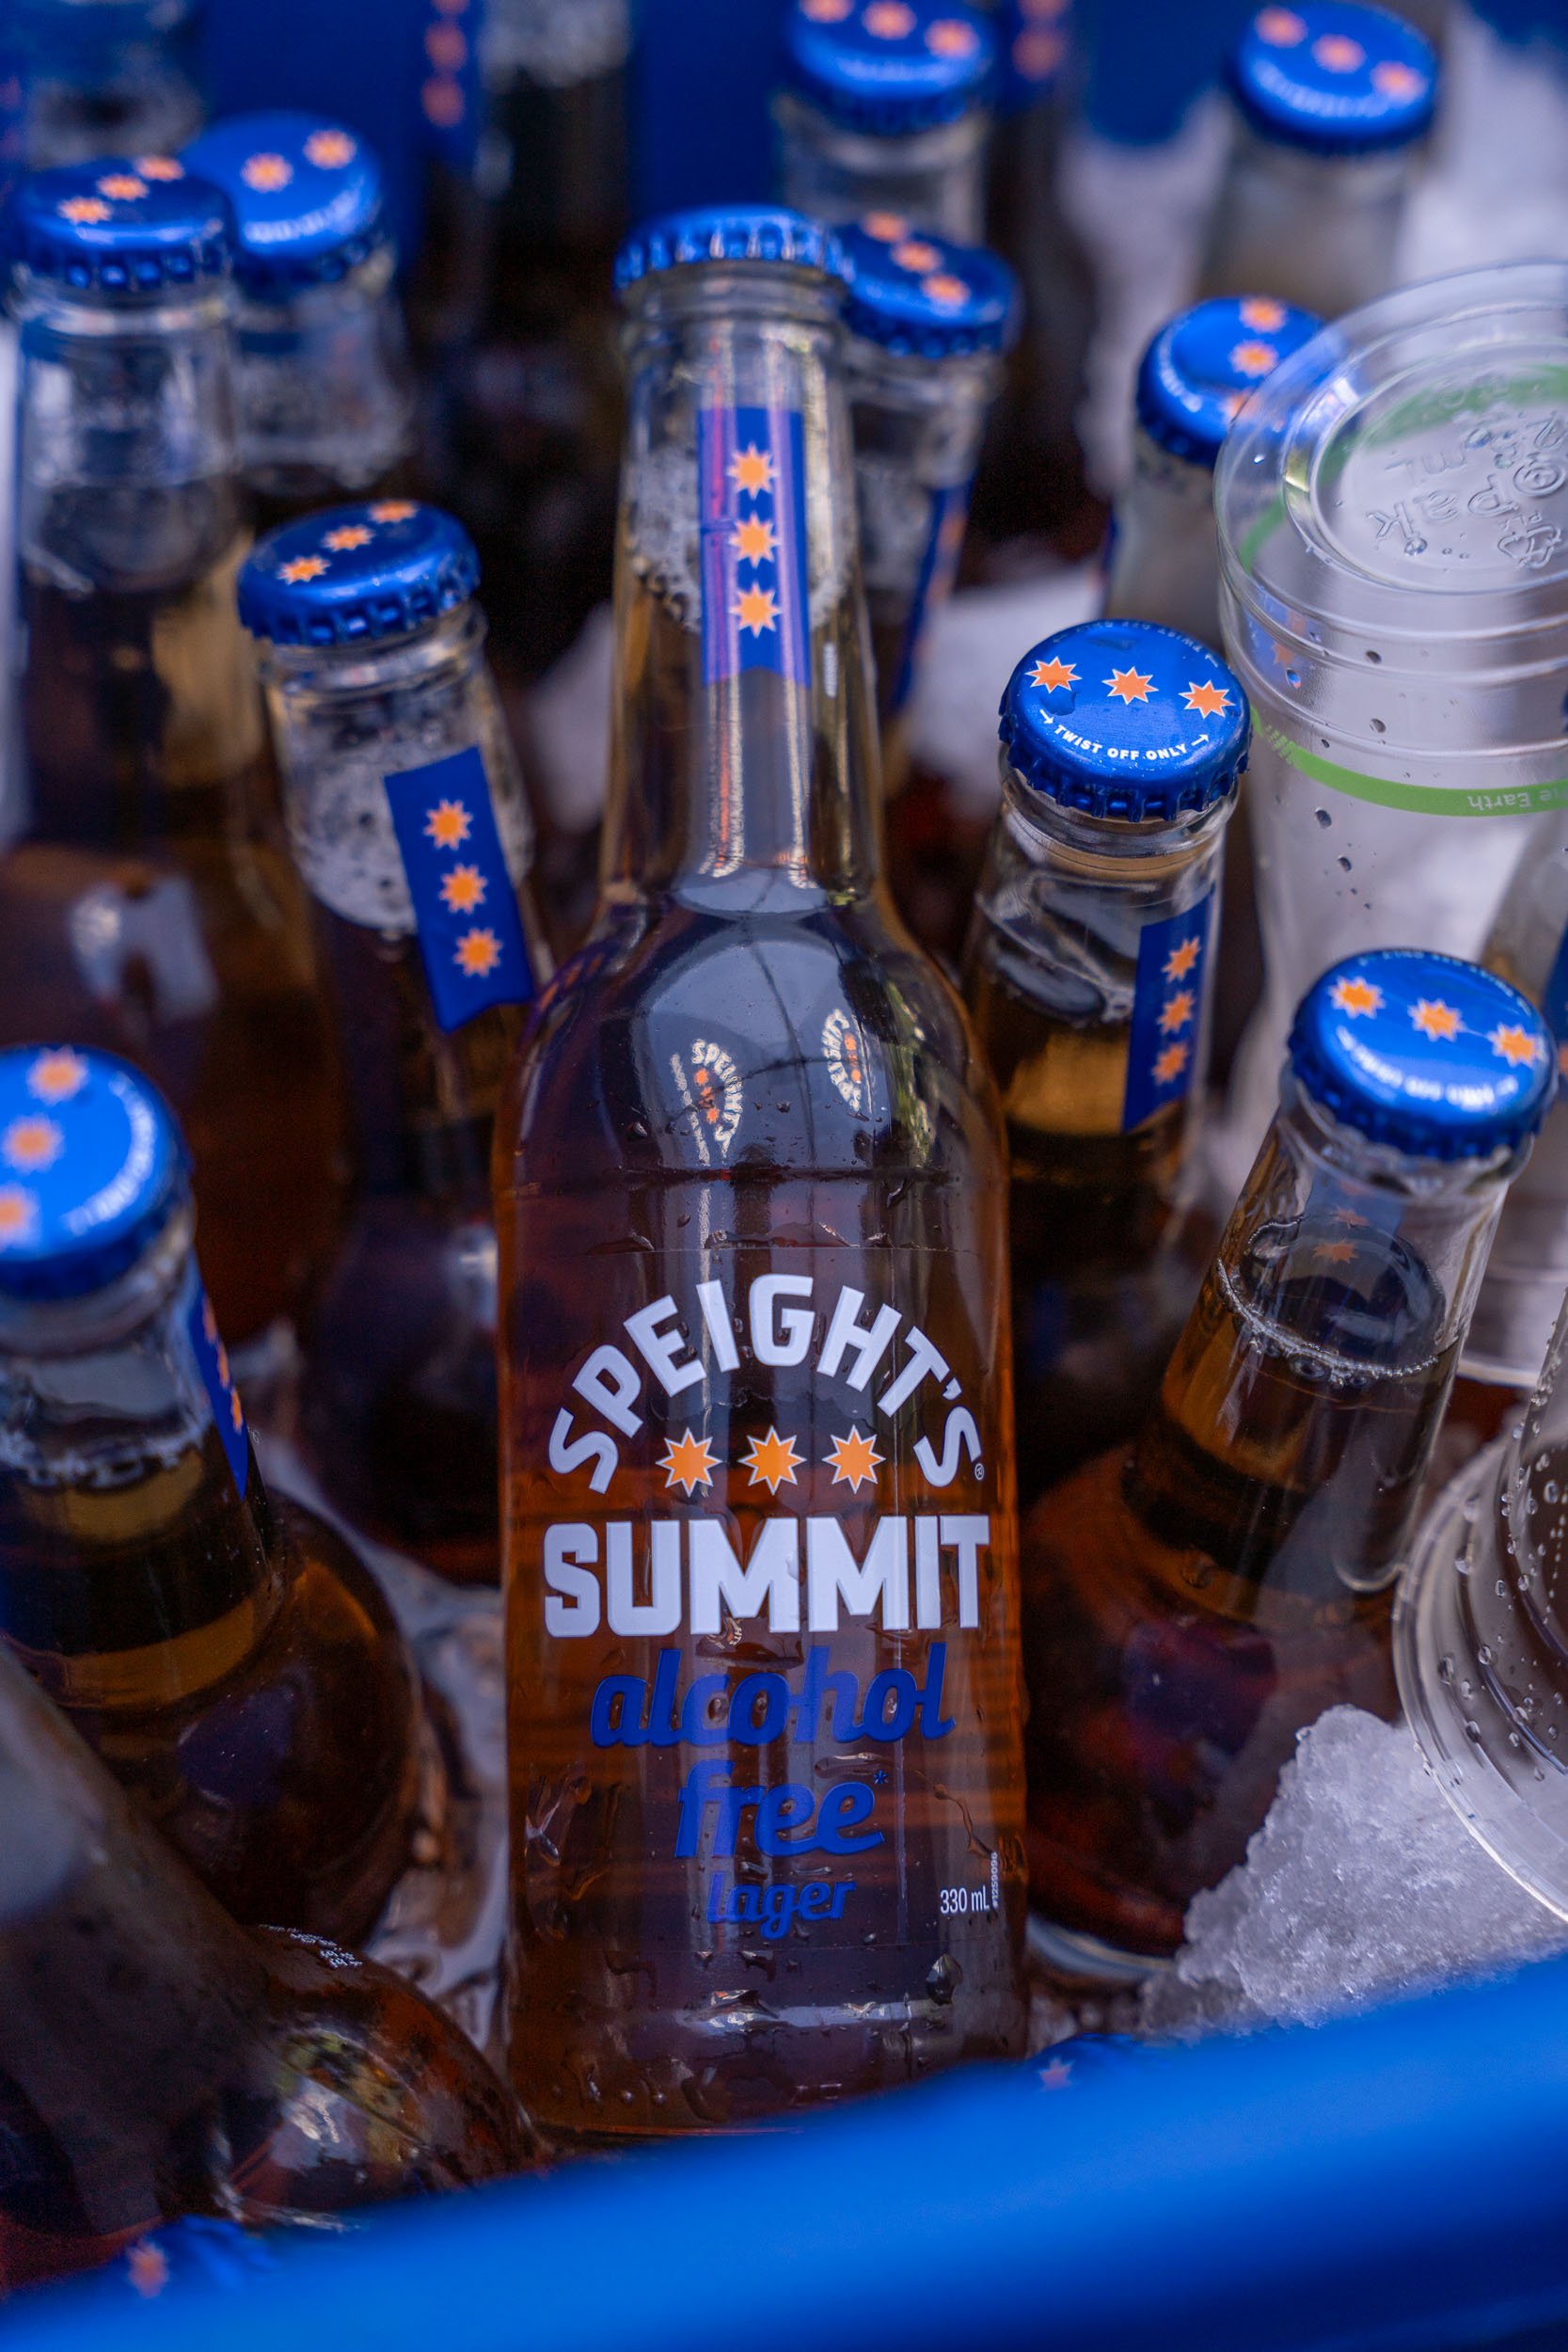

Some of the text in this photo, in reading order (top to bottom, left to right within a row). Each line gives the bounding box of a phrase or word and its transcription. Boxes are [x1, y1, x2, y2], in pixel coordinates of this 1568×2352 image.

[1053, 723, 1188, 761] TWIST OFF ONLY
[1466, 792, 1530, 811] Earth
[544, 1515, 990, 1638] SUMMIT
[590, 1642, 957, 1748] alcohol
[705, 1871, 857, 1940] lager
[940, 1884, 990, 1915] 330 mL
